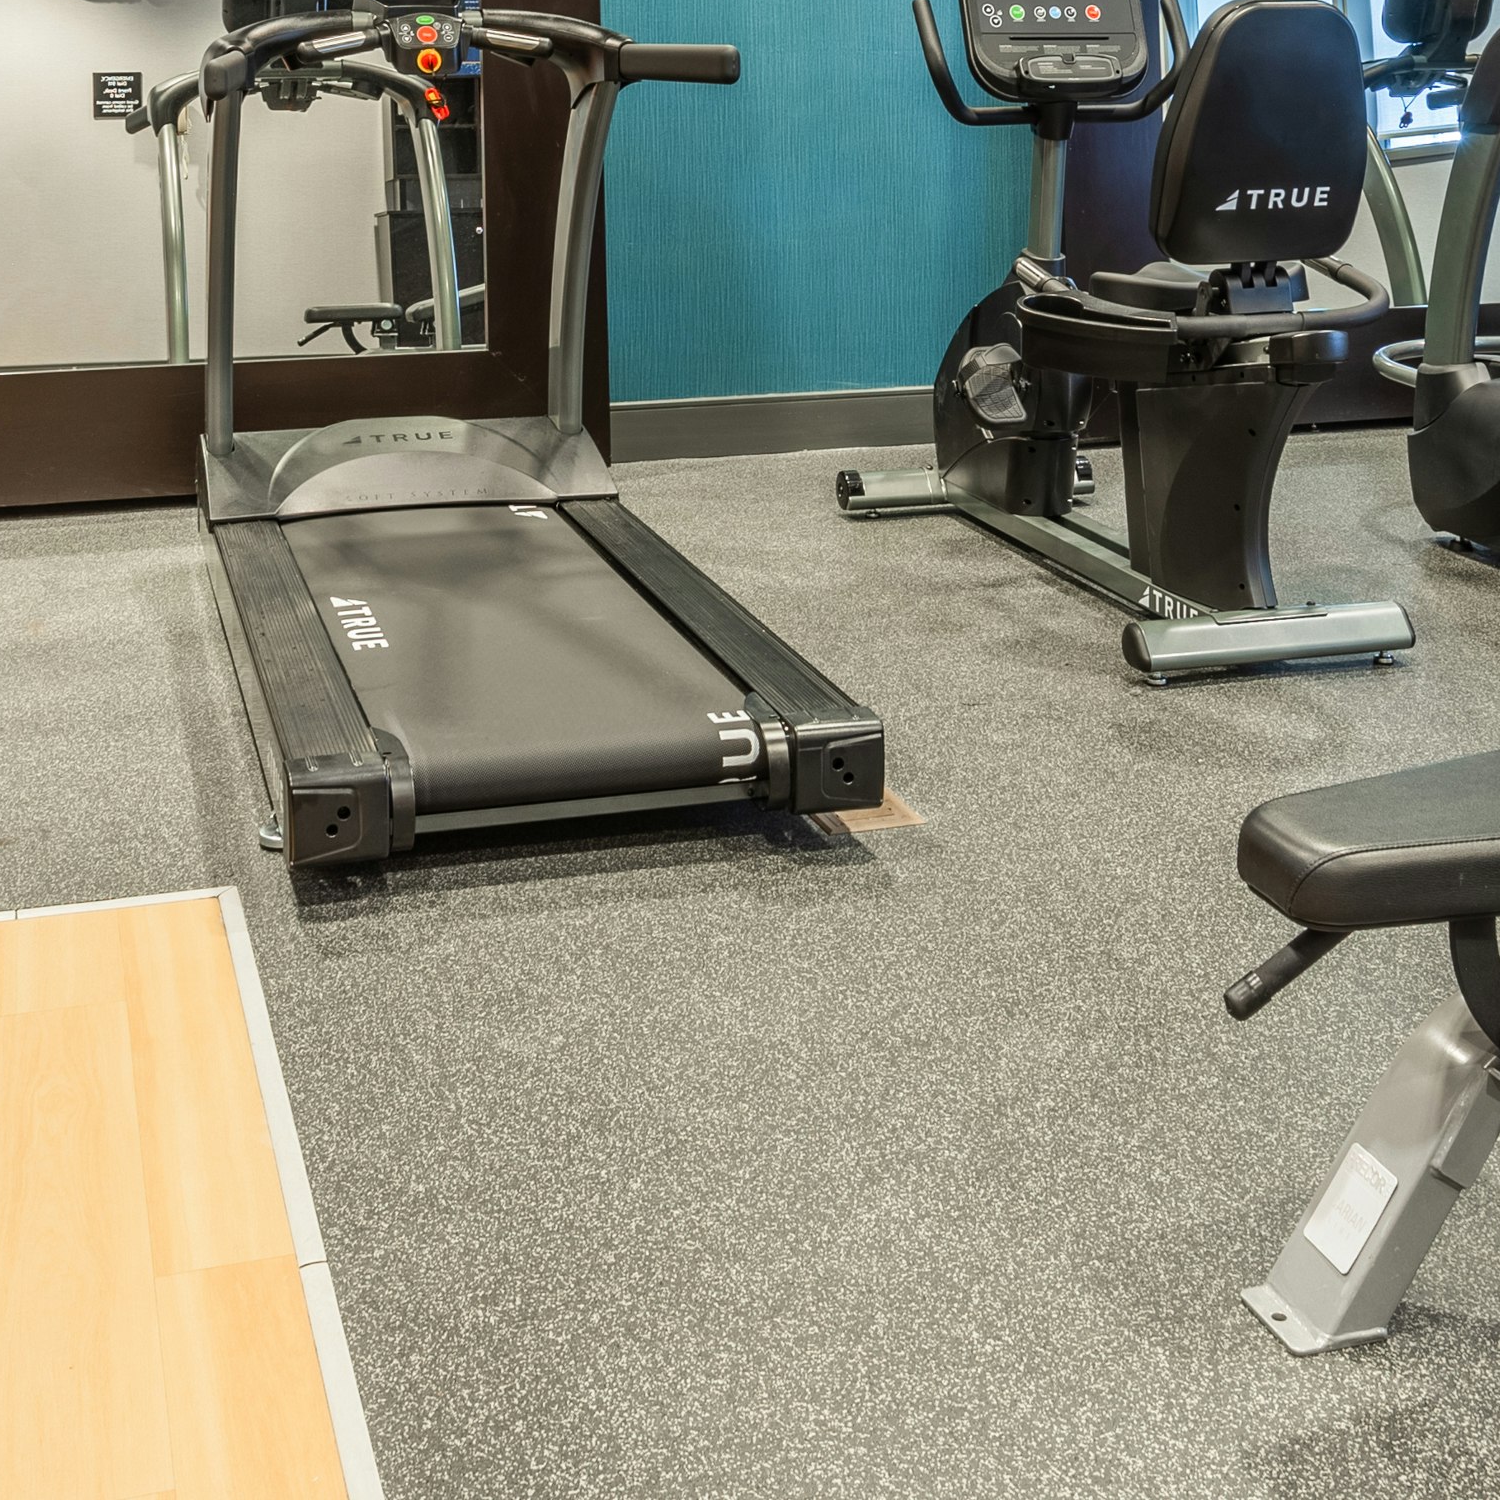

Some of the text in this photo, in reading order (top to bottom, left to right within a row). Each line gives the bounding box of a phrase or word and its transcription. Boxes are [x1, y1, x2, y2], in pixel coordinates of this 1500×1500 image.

[1246, 186, 1331, 210] TRUE
[369, 430, 454, 443] TRUE
[337, 605, 390, 650] TRUE
